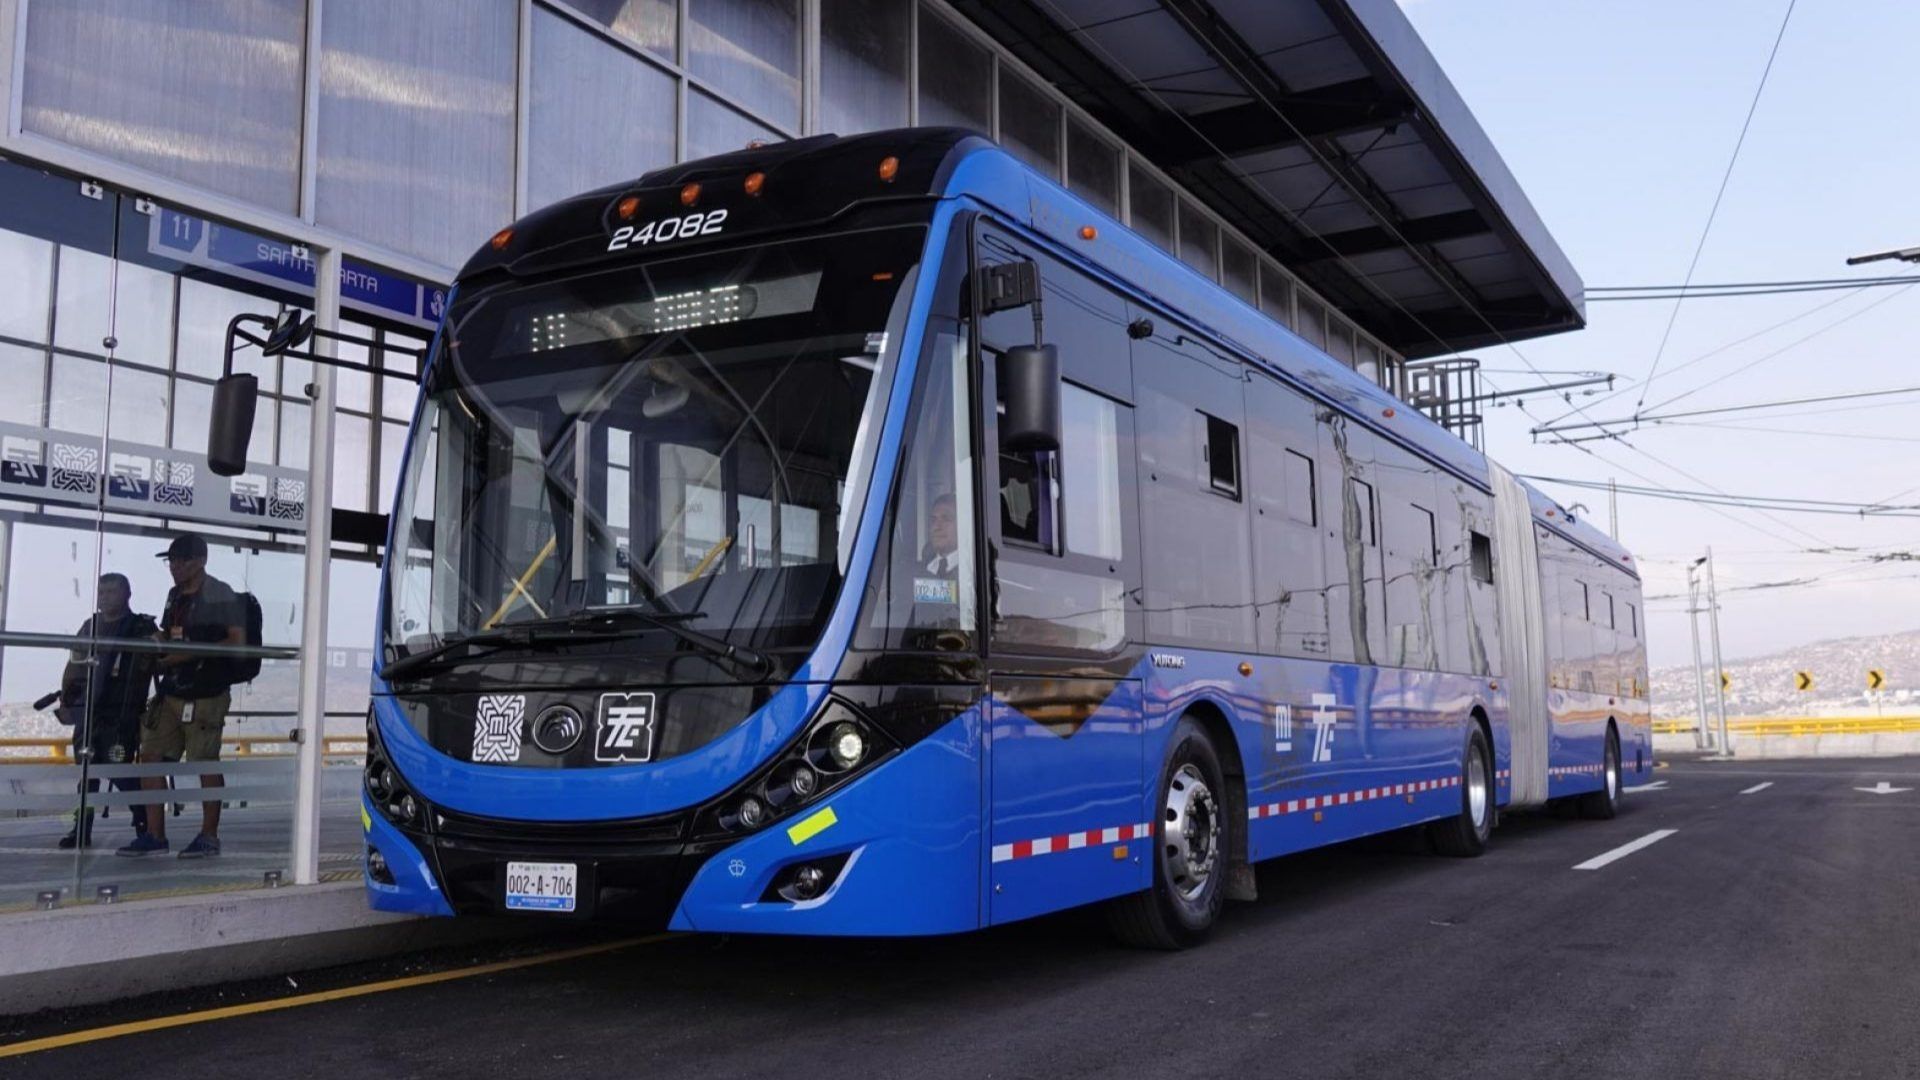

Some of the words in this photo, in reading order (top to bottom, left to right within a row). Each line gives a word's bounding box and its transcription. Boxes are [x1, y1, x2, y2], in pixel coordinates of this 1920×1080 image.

[173, 215, 190, 241] 11
[607, 209, 728, 251] 24082
[340, 268, 377, 293] ARTA
[508, 874, 573, 896] 002-A-706
